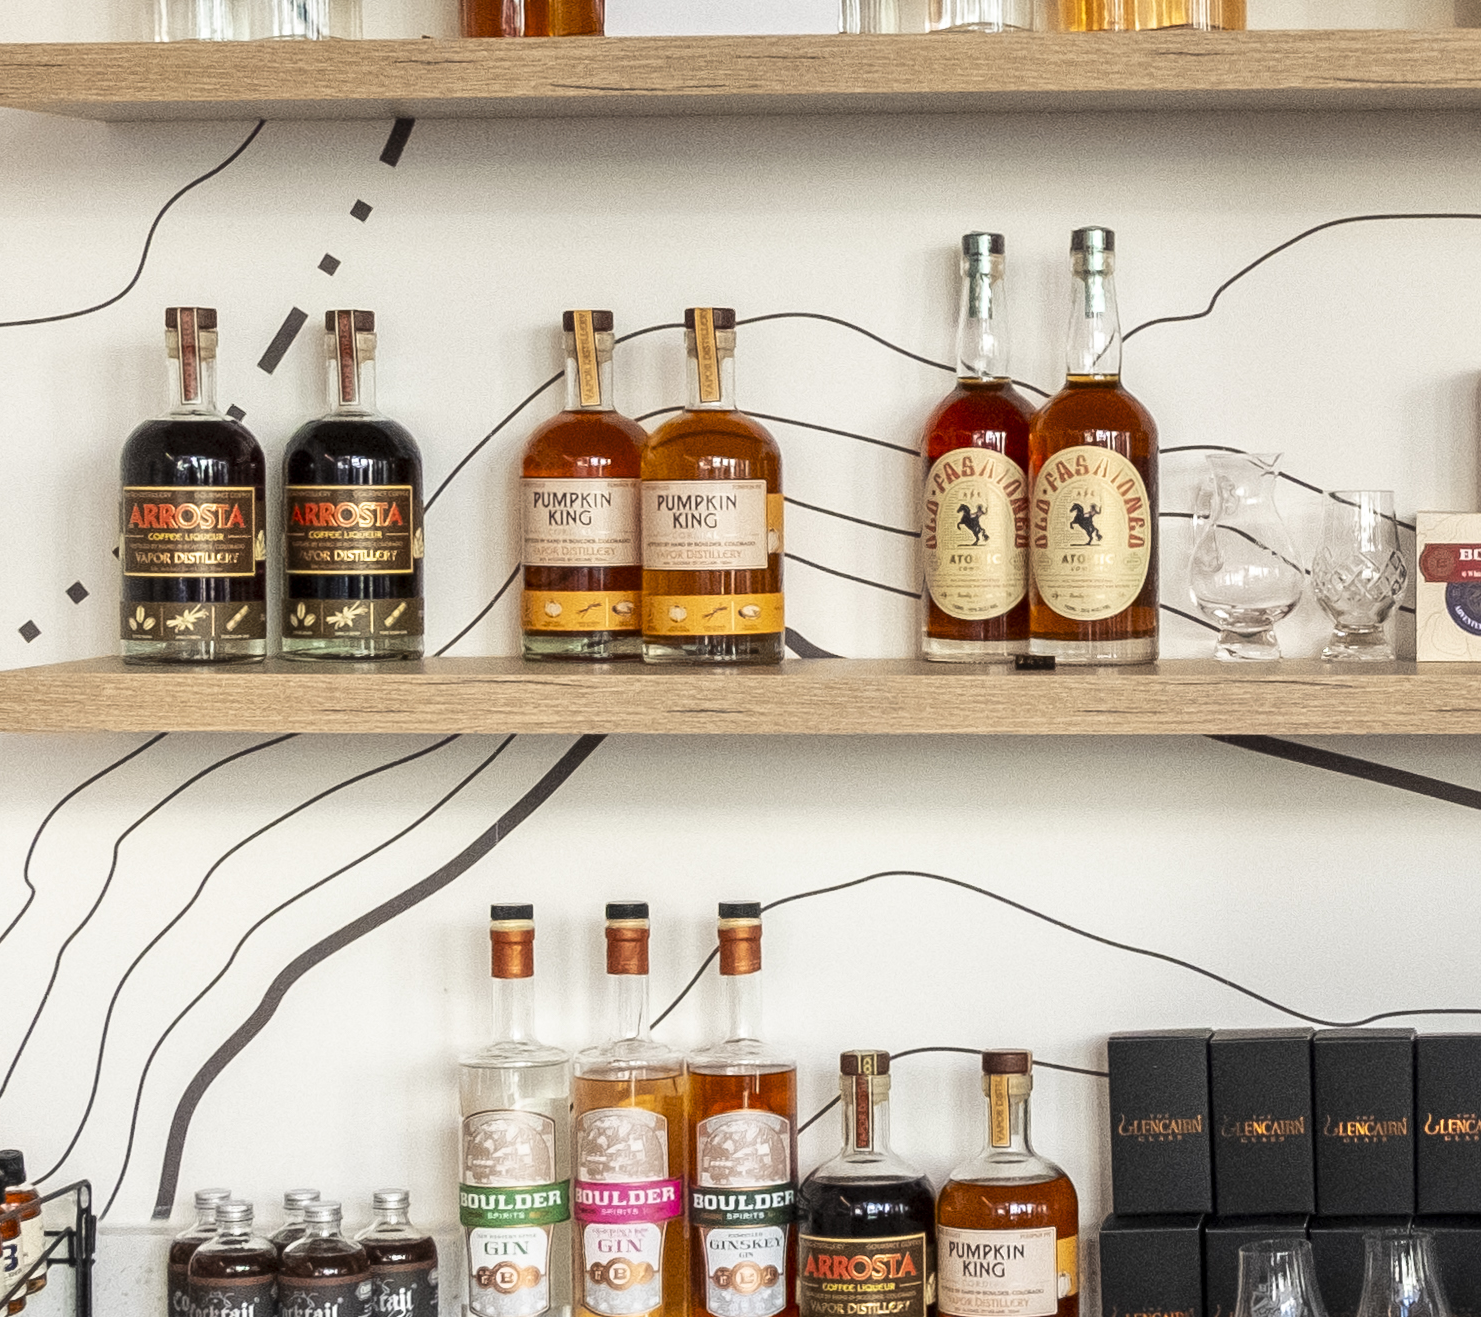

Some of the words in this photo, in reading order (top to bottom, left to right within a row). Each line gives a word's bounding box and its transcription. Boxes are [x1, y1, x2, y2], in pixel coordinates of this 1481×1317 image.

[533, 492, 612, 509] PUMPKIN
[657, 495, 737, 512] PUMPKIN
[129, 503, 246, 529] ARROSTA
[292, 502, 403, 528] ARROSTA
[548, 510, 592, 526] KING
[673, 513, 718, 529] KING
[148, 532, 181, 542] COFFEE
[309, 530, 341, 541] COFFEE
[135, 552, 171, 565] VAPOR
[174, 551, 239, 565] DISTILLERY
[334, 549, 397, 563] DISTILLERY
[1119, 1114, 1202, 1136] GLENCAIRN
[1324, 1115, 1407, 1137] GLENCAIRN
[461, 1190, 562, 1211] BOULDER
[575, 1187, 675, 1207] BOULDER
[694, 1190, 794, 1211] BOULDER
[726, 1211, 765, 1220] SPIRITS
[484, 1239, 529, 1256] GIN
[598, 1236, 642, 1253] GIN
[710, 1236, 782, 1250] GINSKEY
[949, 1241, 1025, 1261] PUMPKIN
[804, 1251, 916, 1281] ARROSTA
[962, 1262, 1006, 1278] KING
[822, 1282, 856, 1292] COFFEE
[847, 1302, 911, 1316] DISTILLERY
